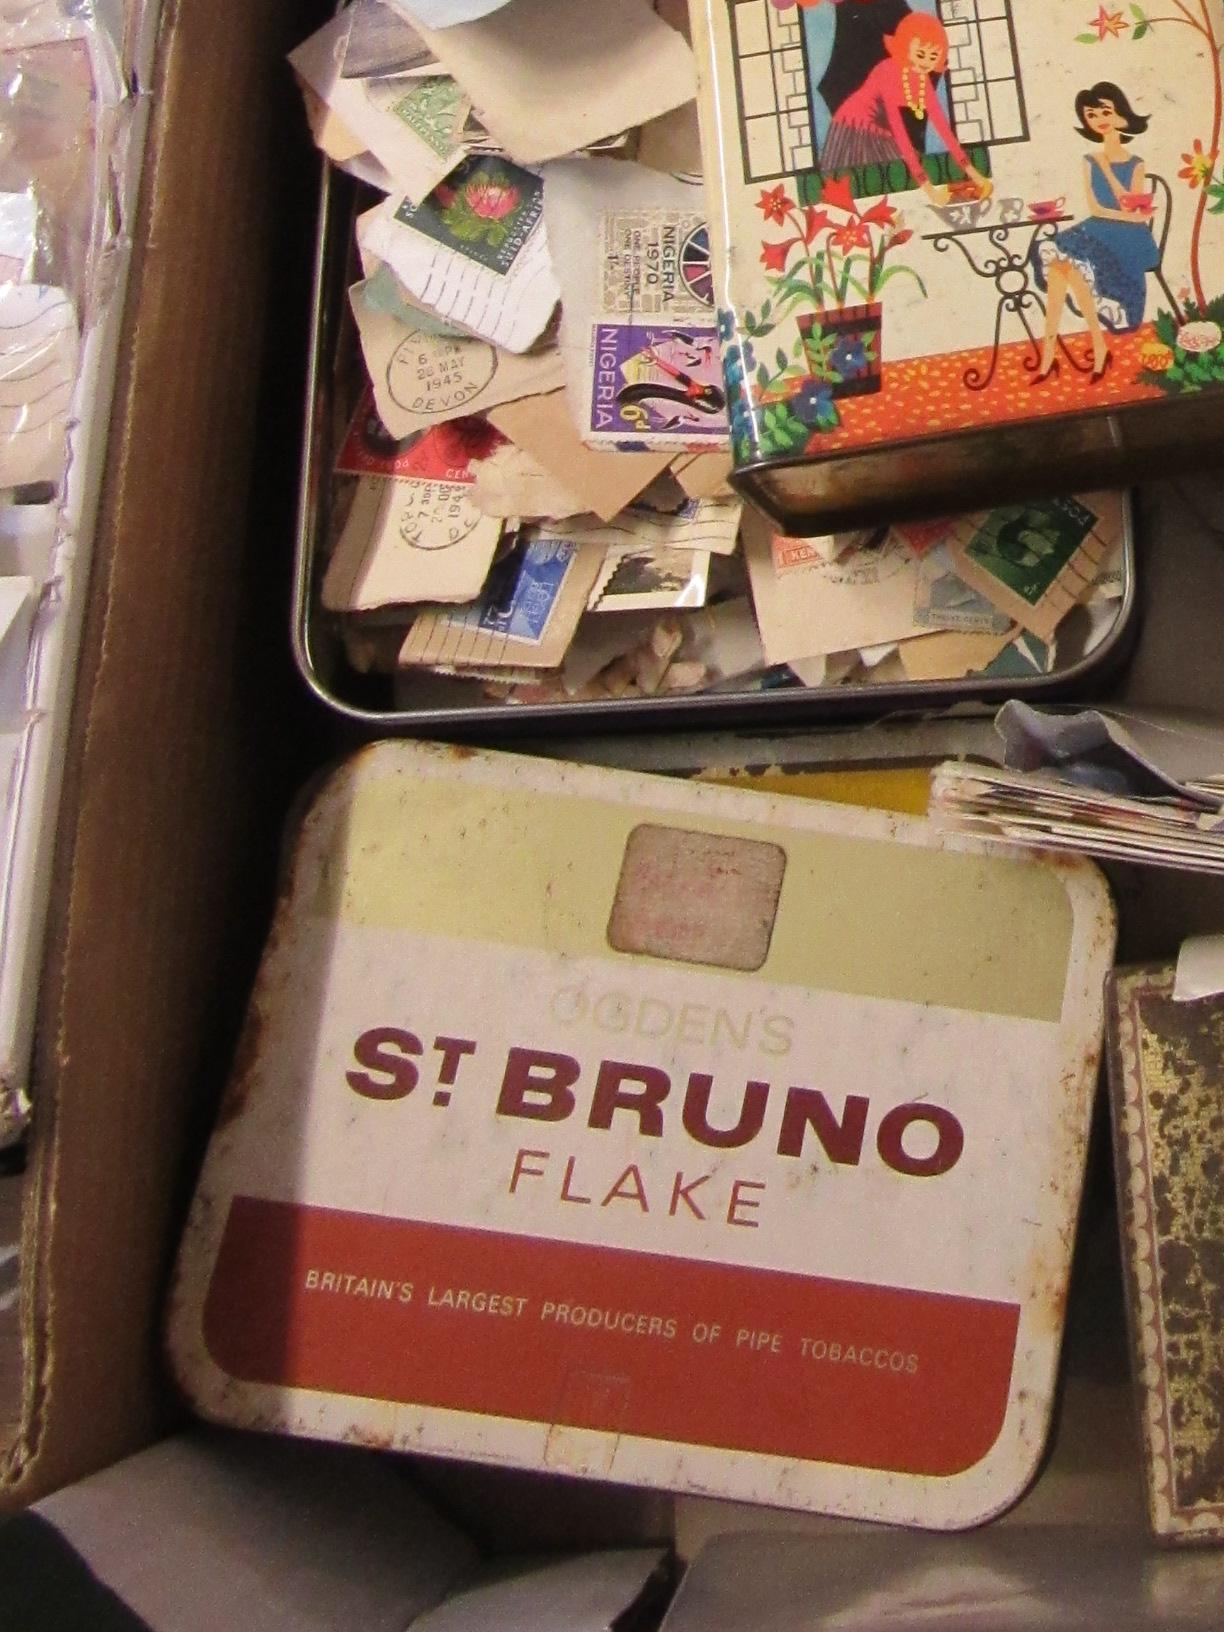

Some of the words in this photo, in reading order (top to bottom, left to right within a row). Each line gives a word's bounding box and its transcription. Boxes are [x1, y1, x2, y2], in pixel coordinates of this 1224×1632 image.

[624, 228, 632, 250] ONE
[633, 230, 641, 250] ONE
[623, 254, 632, 297] DESTINY
[633, 255, 642, 296] PEOPLE
[646, 241, 659, 285] 1970
[661, 226, 676, 302] NIGERIA
[426, 372, 463, 391] 1945
[439, 356, 466, 374] MAY
[596, 328, 618, 429] NIGERIA
[411, 382, 479, 411] DEVON
[620, 405, 651, 430] 6d
[550, 979, 796, 1055] OGDEN'S
[495, 1046, 966, 1178] BRUNO
[508, 1148, 769, 1229] FLAKE
[303, 1269, 414, 1304] BRITAIN'S
[427, 1281, 530, 1319] LARGEST
[540, 1299, 678, 1341] PRODUCERS
[692, 1321, 724, 1344] OF
[735, 1326, 784, 1353] PIPE
[800, 1337, 921, 1374] TOBACCOS
